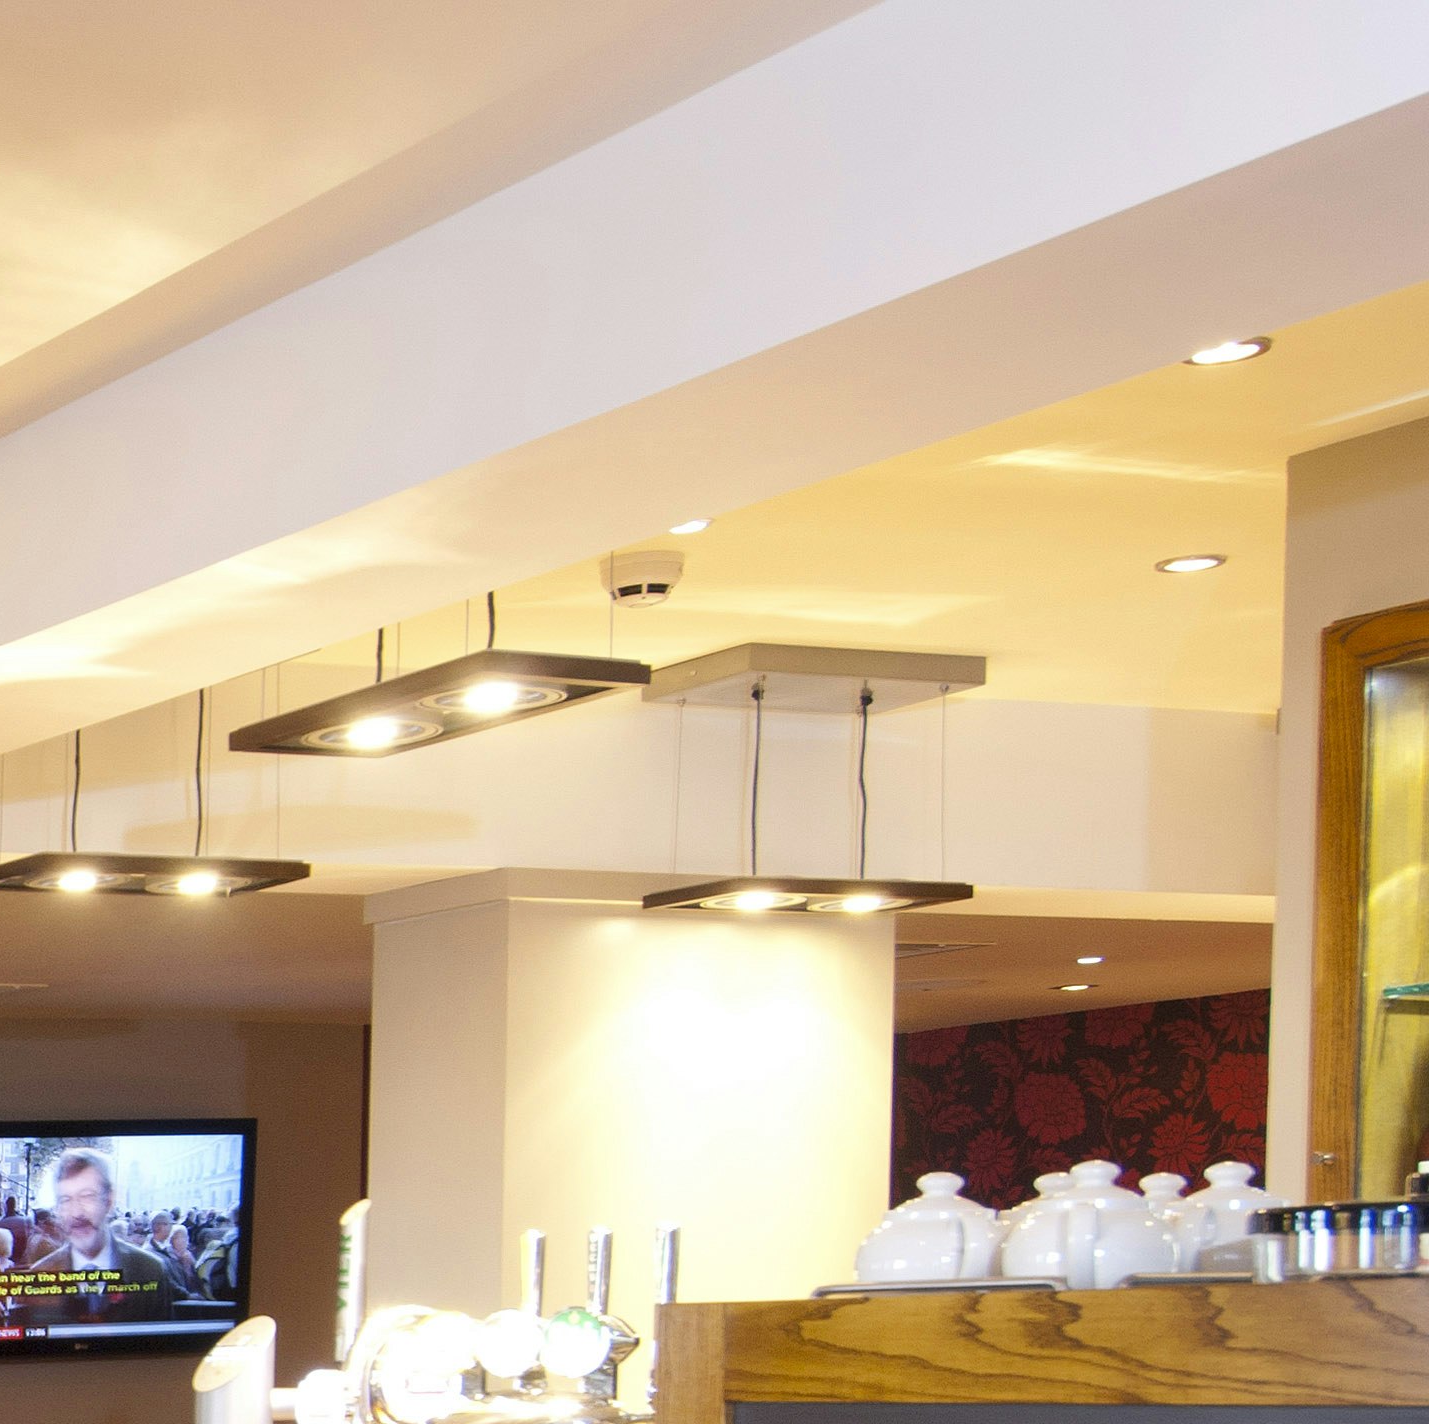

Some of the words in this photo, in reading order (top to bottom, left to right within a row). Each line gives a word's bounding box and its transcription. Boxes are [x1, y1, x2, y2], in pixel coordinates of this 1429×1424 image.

[10, 1273, 35, 1283] hear
[37, 1272, 56, 1282] the
[59, 1271, 86, 1282] band
[88, 1271, 101, 1281] of
[102, 1270, 121, 1280] the
[10, 1286, 23, 1296] of
[24, 1285, 62, 1295] Guards
[65, 1285, 78, 1294] as
[81, 1283, 104, 1296] they
[107, 1283, 140, 1292] march
[142, 1281, 158, 1291] off
